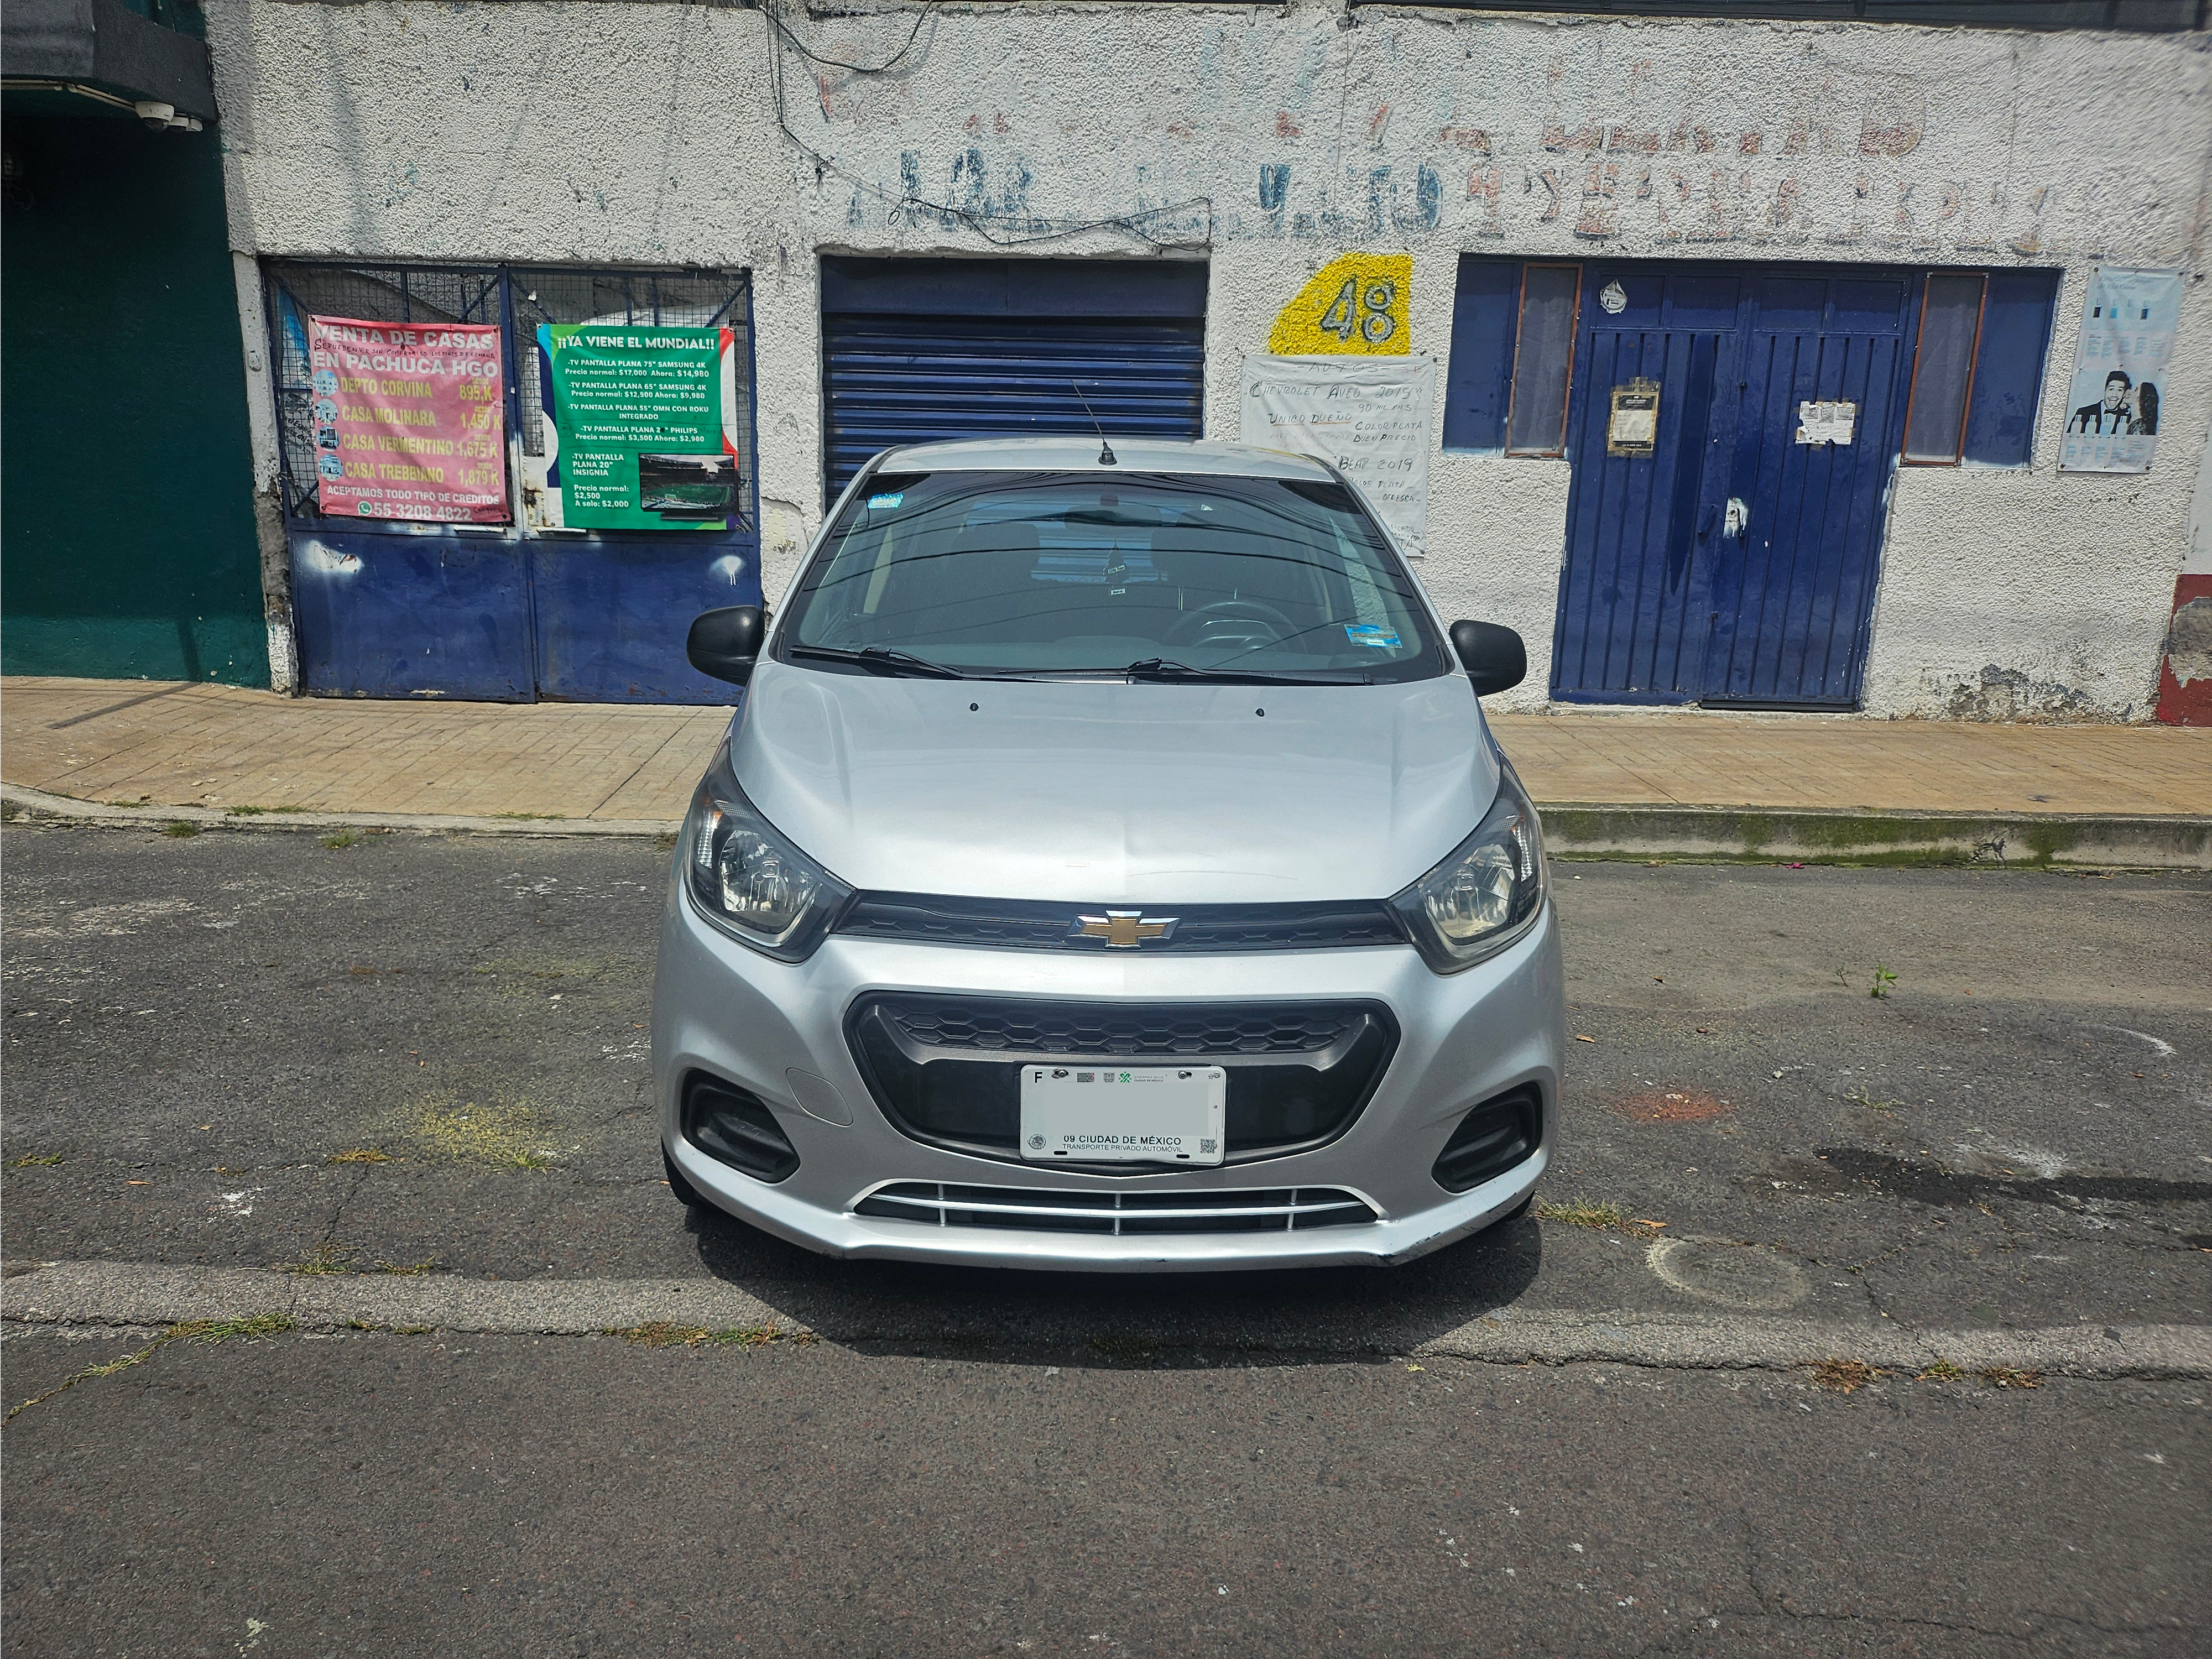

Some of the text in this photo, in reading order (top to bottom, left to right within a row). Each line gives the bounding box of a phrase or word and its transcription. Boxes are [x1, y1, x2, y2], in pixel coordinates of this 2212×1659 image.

[1319, 276, 1395, 343] 48
[316, 323, 493, 350] VENTA DE CASAS
[586, 336, 624, 348] VIENE
[627, 337, 642, 348] EL
[645, 337, 714, 350] MUNDIAL!!
[313, 351, 498, 377] EN PACHUCA HGO
[340, 377, 378, 395] DEPTO
[381, 379, 433, 398] CORVINA
[1249, 380, 1321, 397] CHEVROLET
[1326, 384, 1360, 399] AVEO
[1375, 386, 1410, 399] 2015
[342, 405, 501, 431] CASA MOLINARA 1,450 K
[1311, 411, 1352, 424] DUEÑO
[1358, 404, 1371, 413] 90
[1355, 421, 1422, 430] COLOR PLATA
[343, 433, 498, 460] CASA VERMENTINO 1,675 K
[1338, 456, 1413, 472] BEAT 2019
[345, 462, 499, 488] CASA TREBBIANO 1,879 K
[327, 485, 500, 504] ACEPTAMOS TODO TIPO DE CREDITOS
[374, 502, 391, 517] 55
[396, 503, 432, 520] 3208
[436, 505, 473, 521] 4822
[1034, 1071, 1042, 1083] F
[1078, 1135, 1119, 1144] CIUDAD
[1140, 1135, 1181, 1145] MÉXICO
